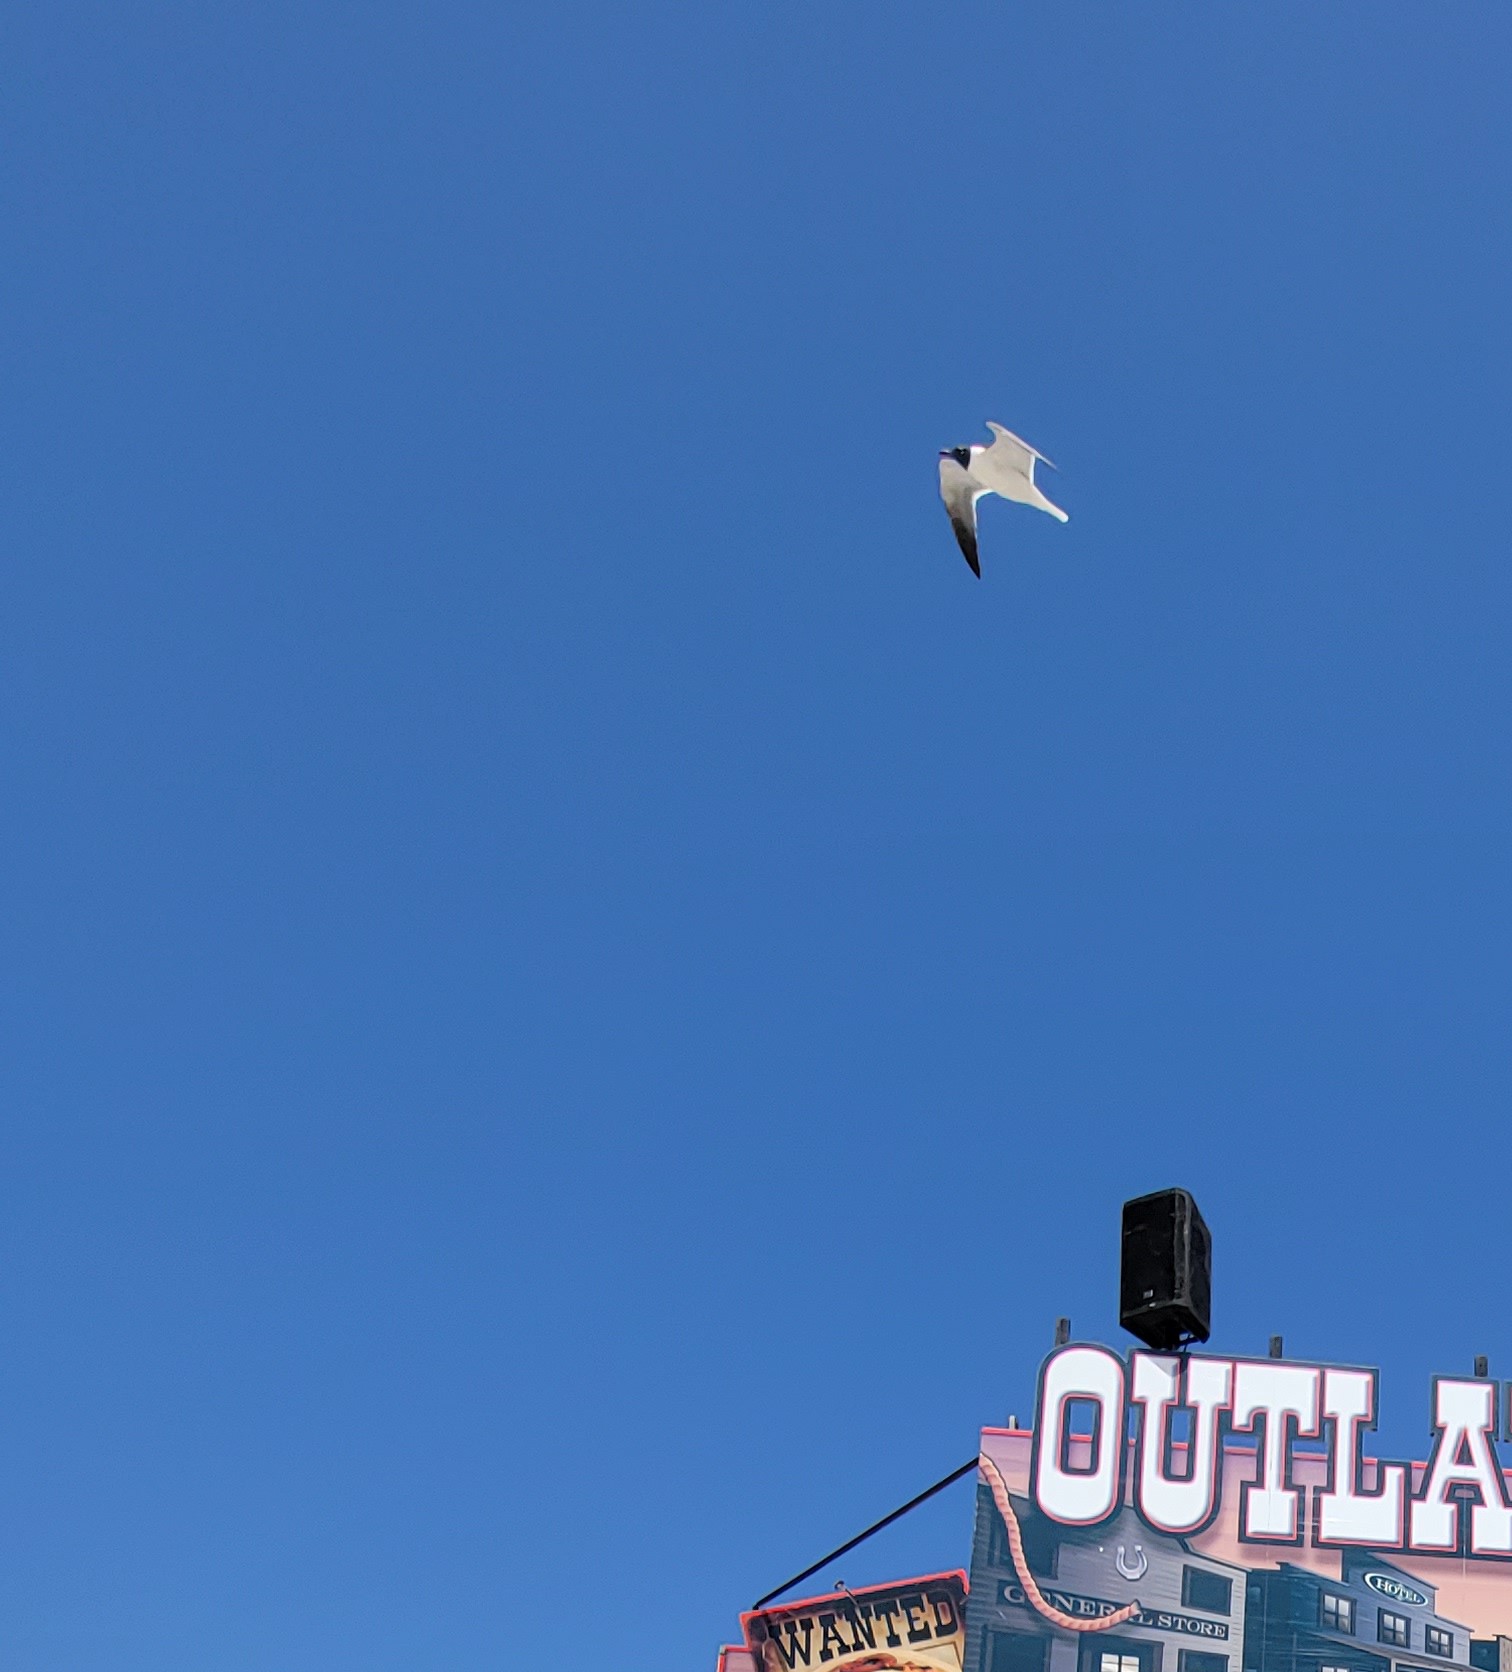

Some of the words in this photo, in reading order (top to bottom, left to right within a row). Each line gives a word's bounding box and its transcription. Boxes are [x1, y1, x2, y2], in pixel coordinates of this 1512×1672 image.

[1003, 1585, 1152, 1625] GNERL
[1157, 1614, 1226, 1638] STORE
[1376, 1577, 1420, 1604] HOTEL
[767, 1593, 959, 1670] WANTED
